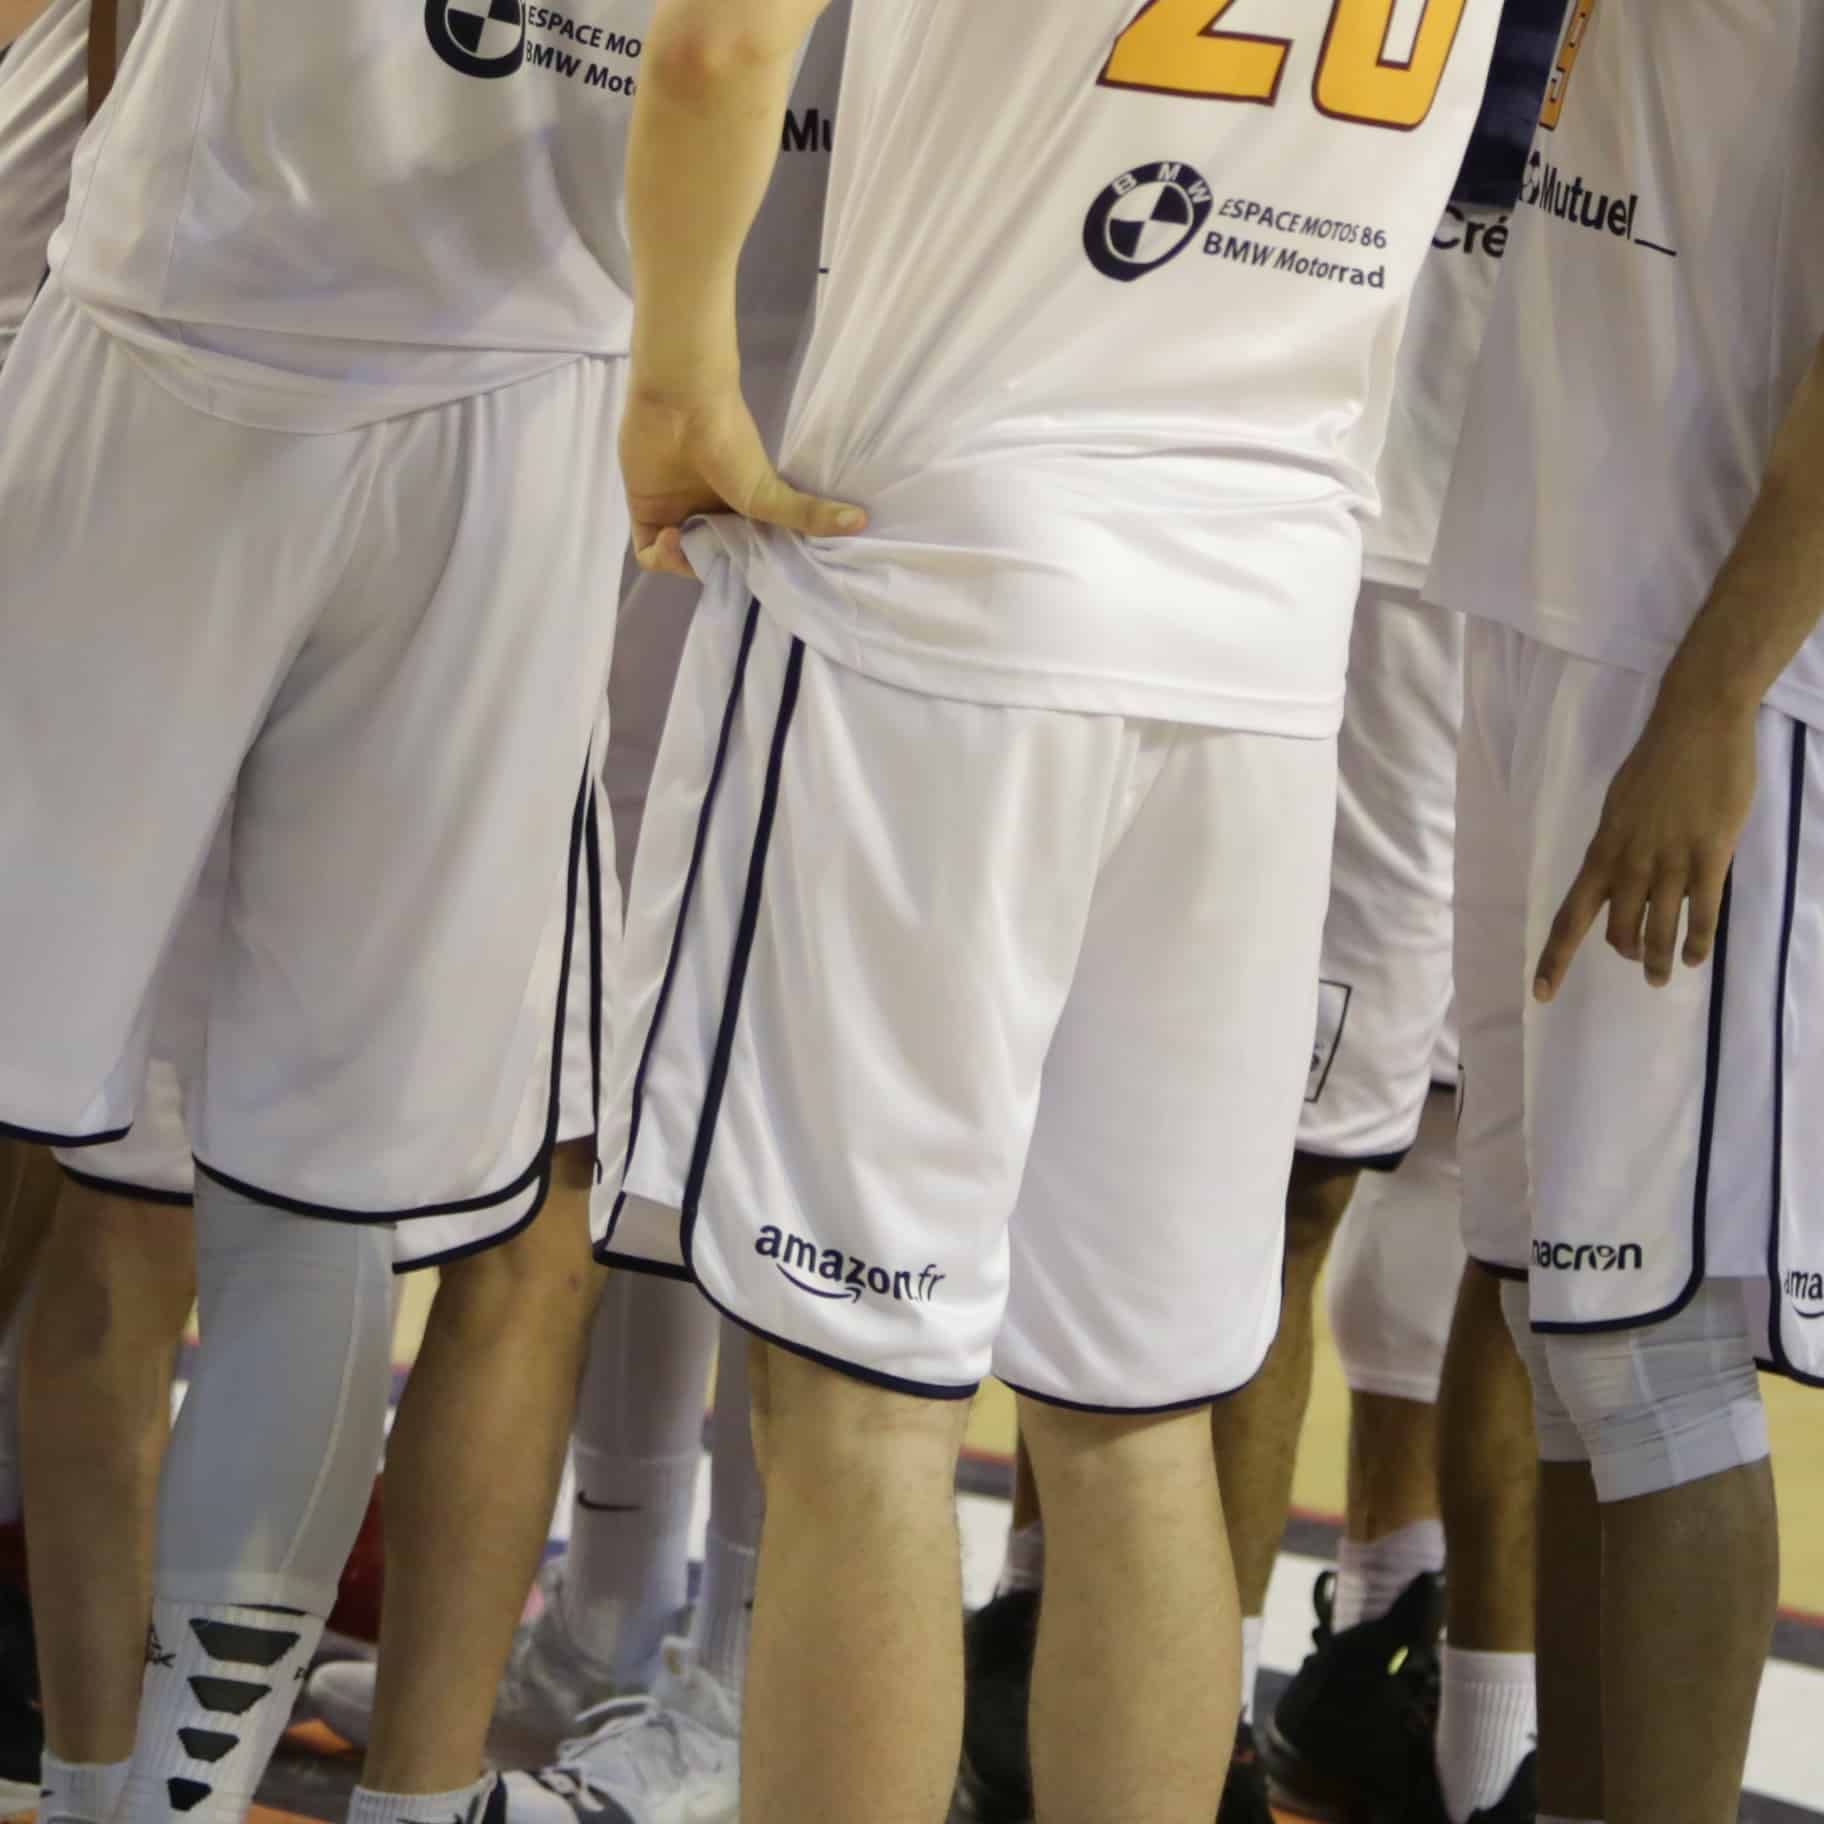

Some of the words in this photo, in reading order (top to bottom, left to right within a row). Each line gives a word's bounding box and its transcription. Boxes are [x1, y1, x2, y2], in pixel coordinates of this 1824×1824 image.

[528, 5, 603, 48] ESPACE
[605, 32, 642, 59] MO
[527, 40, 582, 78] BMW
[584, 62, 635, 97] Mot
[1219, 198, 1302, 233] ESPACE
[1300, 215, 1360, 244] MOTOS
[1360, 226, 1387, 250] 86
[1202, 231, 1274, 267] BMW
[1274, 248, 1386, 290] Motorrad
